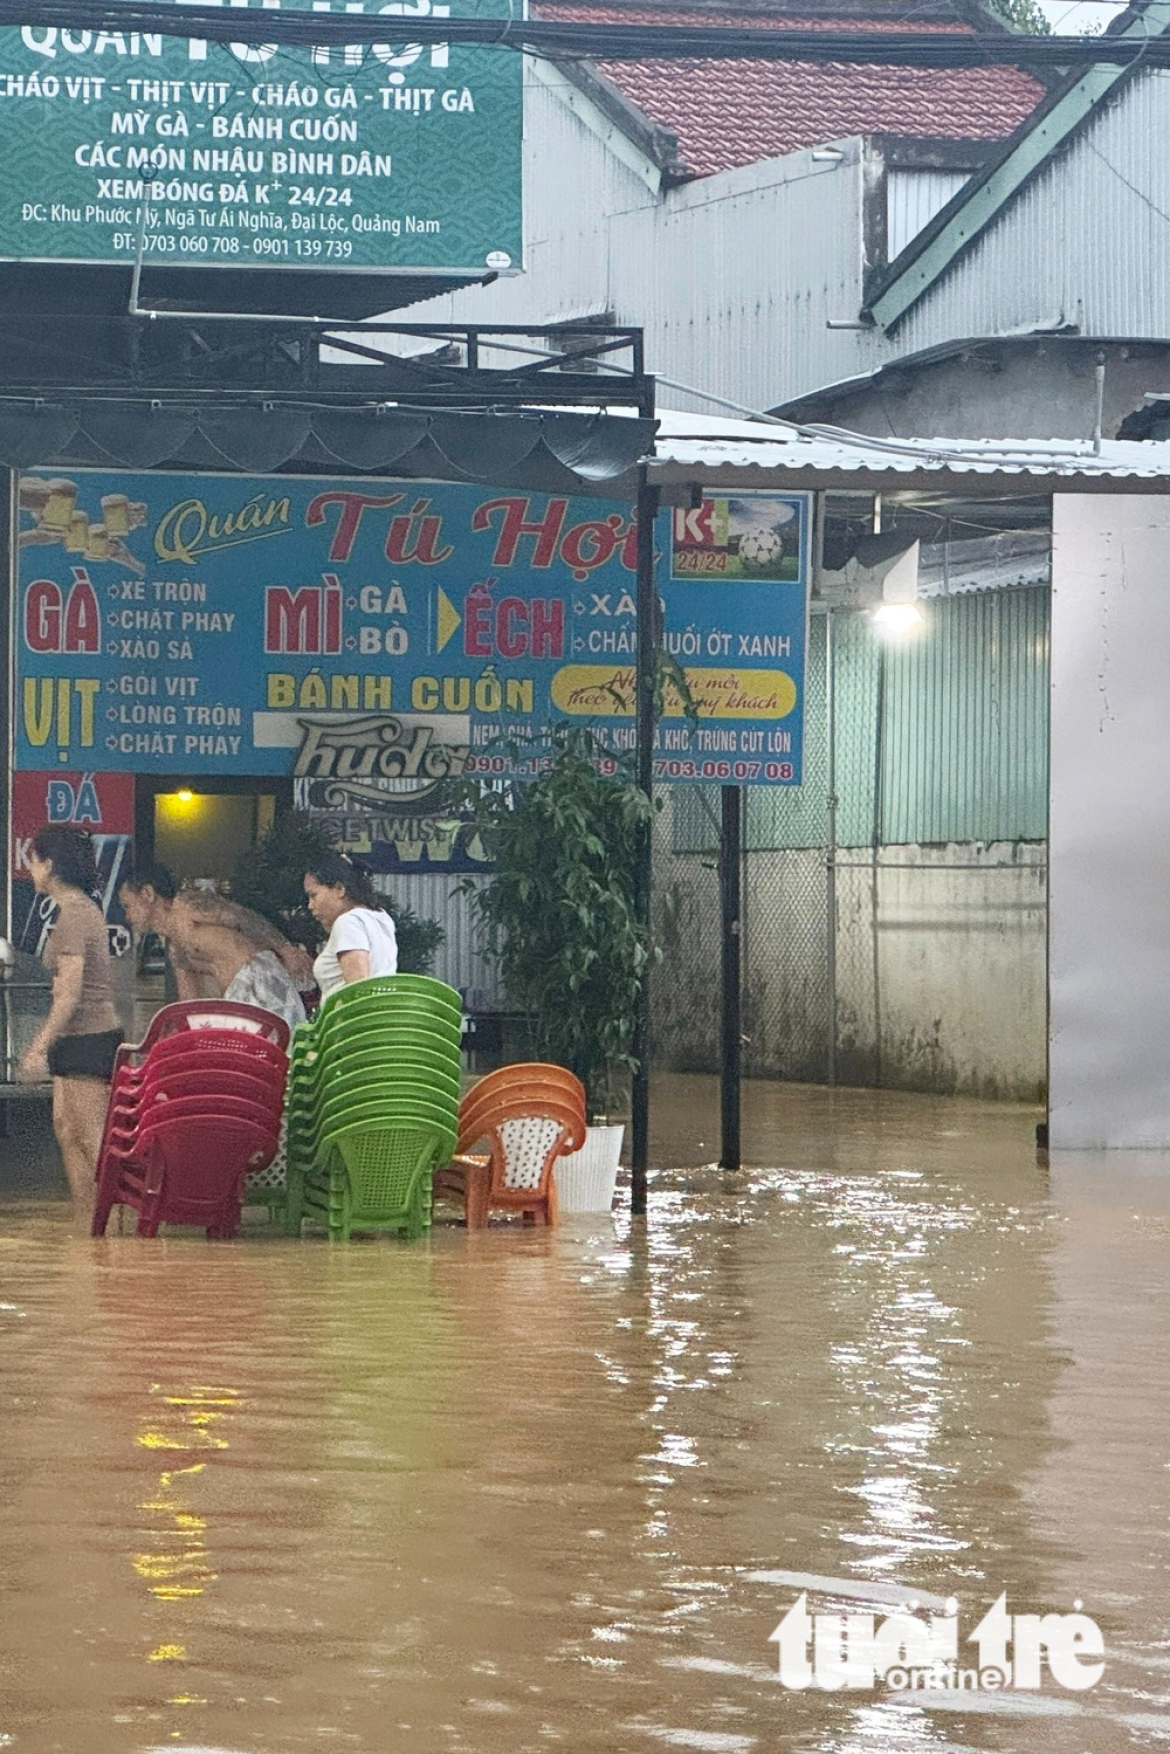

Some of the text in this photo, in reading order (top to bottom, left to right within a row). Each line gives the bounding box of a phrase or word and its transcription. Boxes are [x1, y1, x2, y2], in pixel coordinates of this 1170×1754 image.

[65, 76, 105, 104] VỊT
[127, 79, 184, 108] THỊT
[190, 81, 230, 110] VỊT
[252, 81, 318, 108] CHÁO
[324, 83, 358, 109] GÀ
[379, 88, 435, 116] THỊT
[441, 87, 475, 112] GÀ
[111, 109, 150, 135] MỲ
[156, 111, 189, 137] GÀ
[213, 112, 283, 139] BÁNH
[290, 113, 358, 142] CUỐN
[75, 140, 392, 178] CÁC MÓN NHẬU BÌNH DÂN
[97, 178, 144, 200] XEM
[151, 178, 214, 202] BÓNG
[219, 180, 249, 203] ĐÁ
[288, 186, 352, 206] 24/24
[22, 204, 47, 222] ĐC:
[51, 204, 81, 222] Khu
[86, 206, 132, 224] Phước
[165, 210, 194, 230] Ngã
[199, 209, 216, 227] Tư
[219, 207, 234, 227] Ái
[239, 211, 288, 232] Nghĩa,
[291, 212, 315, 234] Đại
[320, 213, 349, 235] Lộc,
[352, 213, 400, 236] Quảng
[405, 215, 440, 233] Nam
[113, 233, 135, 250] ĐT:
[142, 234, 175, 252] 0703
[180, 235, 208, 252] 060
[212, 236, 239, 253] 708
[253, 238, 288, 255] 0901
[295, 239, 322, 256] 139
[327, 240, 352, 258] 739
[154, 494, 292, 565] Quán
[306, 491, 454, 565] Tú
[677, 551, 727, 572] 24/24
[120, 576, 207, 606] XÉ TRỘN
[359, 579, 408, 614] GÀ
[24, 567, 101, 654] GÀ
[120, 608, 235, 634] CHẶT PHAY
[264, 573, 342, 655] MÌ
[463, 577, 565, 660] ẾCH
[120, 635, 160, 659] XÀO
[359, 620, 408, 655] BÒ
[707, 627, 732, 656] ỚT
[738, 634, 791, 657] XANH
[165, 676, 199, 701] VỊT
[266, 664, 534, 711] BÁNH CUỐN
[726, 692, 778, 710] khách
[23, 676, 100, 763] VỊT
[120, 700, 241, 730] LÒNG TRỘN
[120, 730, 241, 758] CHẶT PHAY
[294, 715, 471, 778] huda
[665, 724, 692, 754] KHÔ,
[697, 726, 736, 751] TRỨNG
[741, 726, 764, 752] CÚT
[768, 727, 792, 759] LỘN
[653, 759, 733, 779] 703.06
[765, 762, 793, 780] 08
[46, 772, 102, 823] ĐÁ
